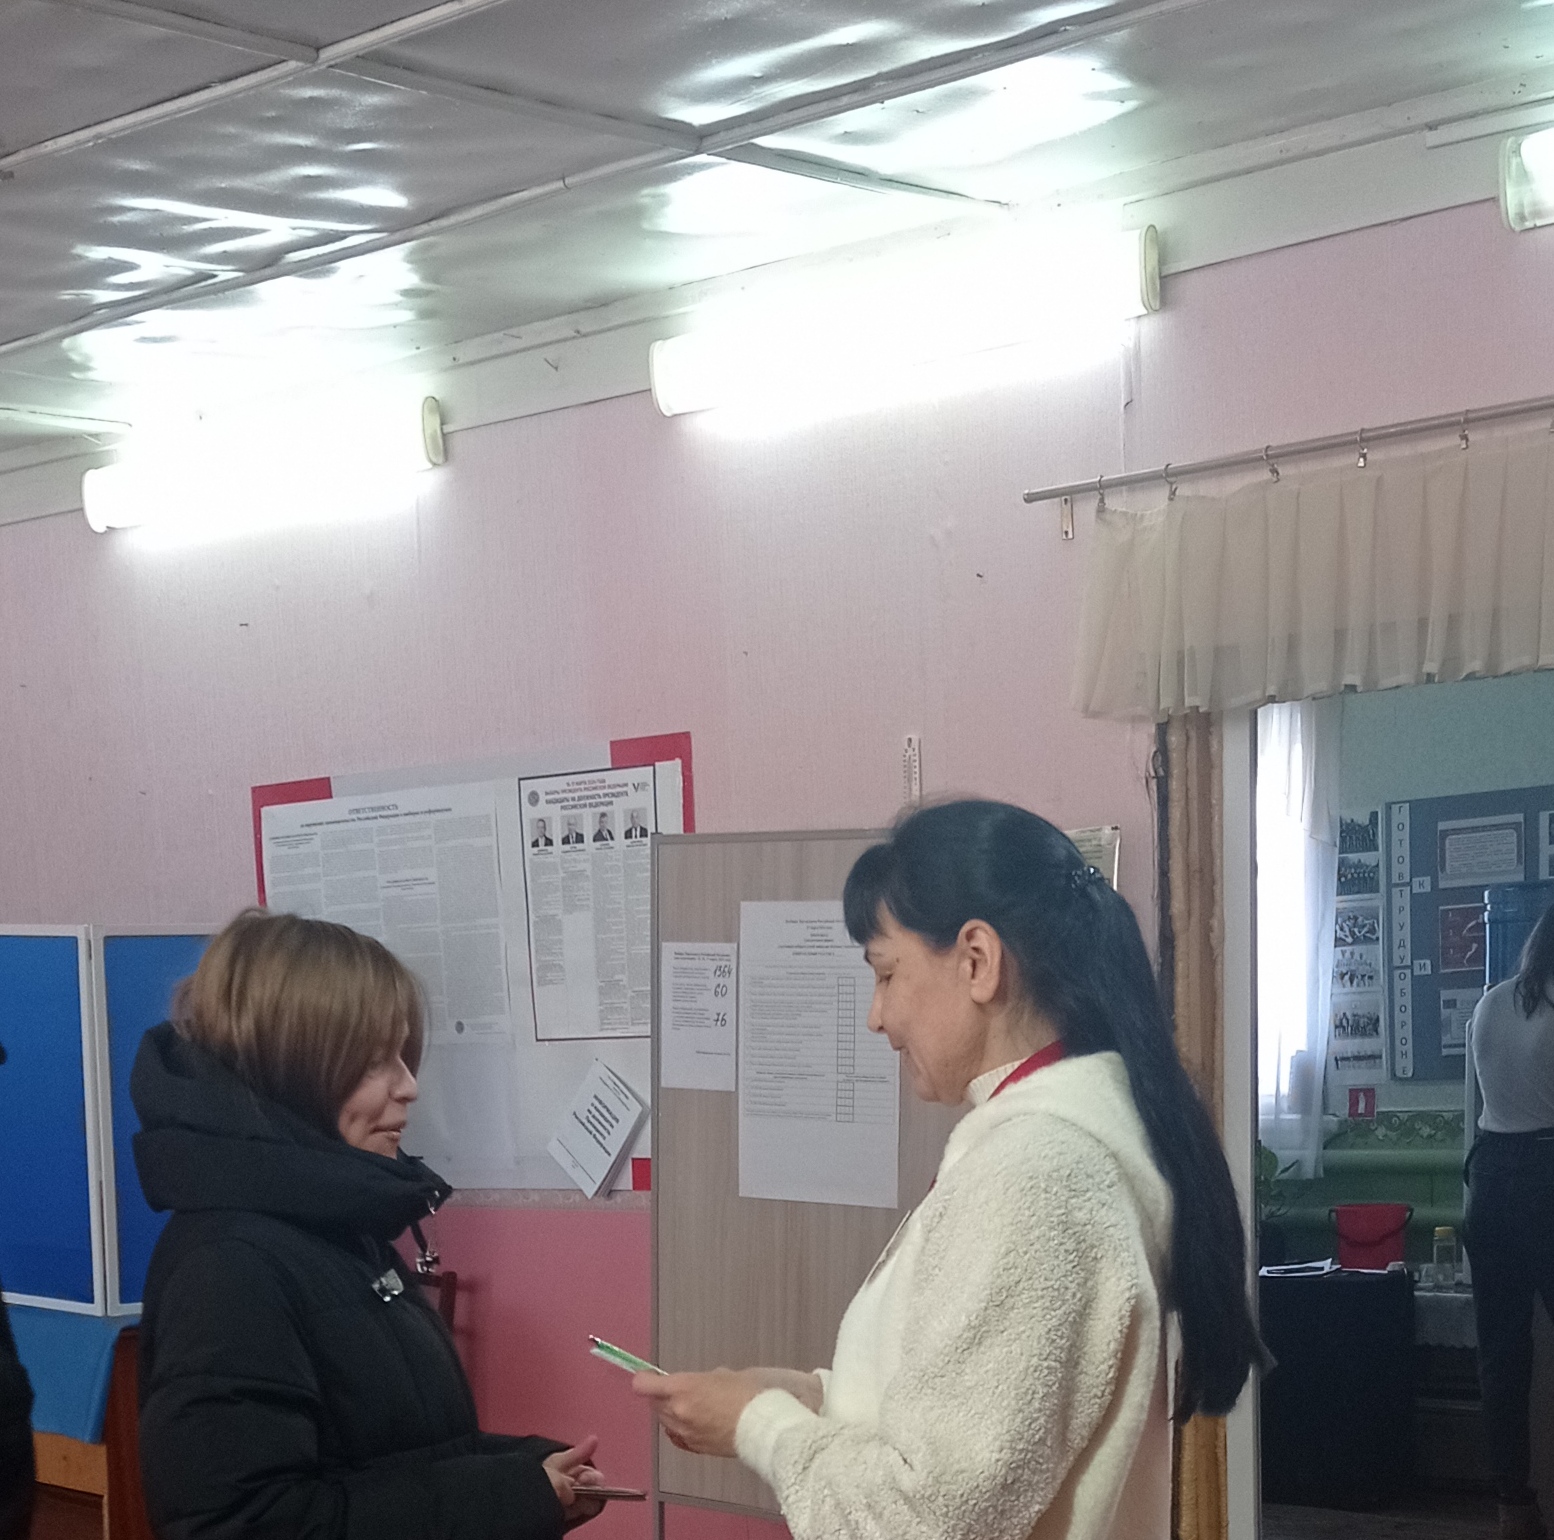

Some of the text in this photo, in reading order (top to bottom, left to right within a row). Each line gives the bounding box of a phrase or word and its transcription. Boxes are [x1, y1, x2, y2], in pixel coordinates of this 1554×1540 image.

[1397, 806, 1405, 881] ГОТОВ
[1397, 889, 1406, 964] ТРУДУ
[1420, 962, 1427, 972] И
[714, 983, 728, 997] 60
[713, 1012, 728, 1027] 76
[1398, 972, 1408, 1076] ОБОРОНЕ
